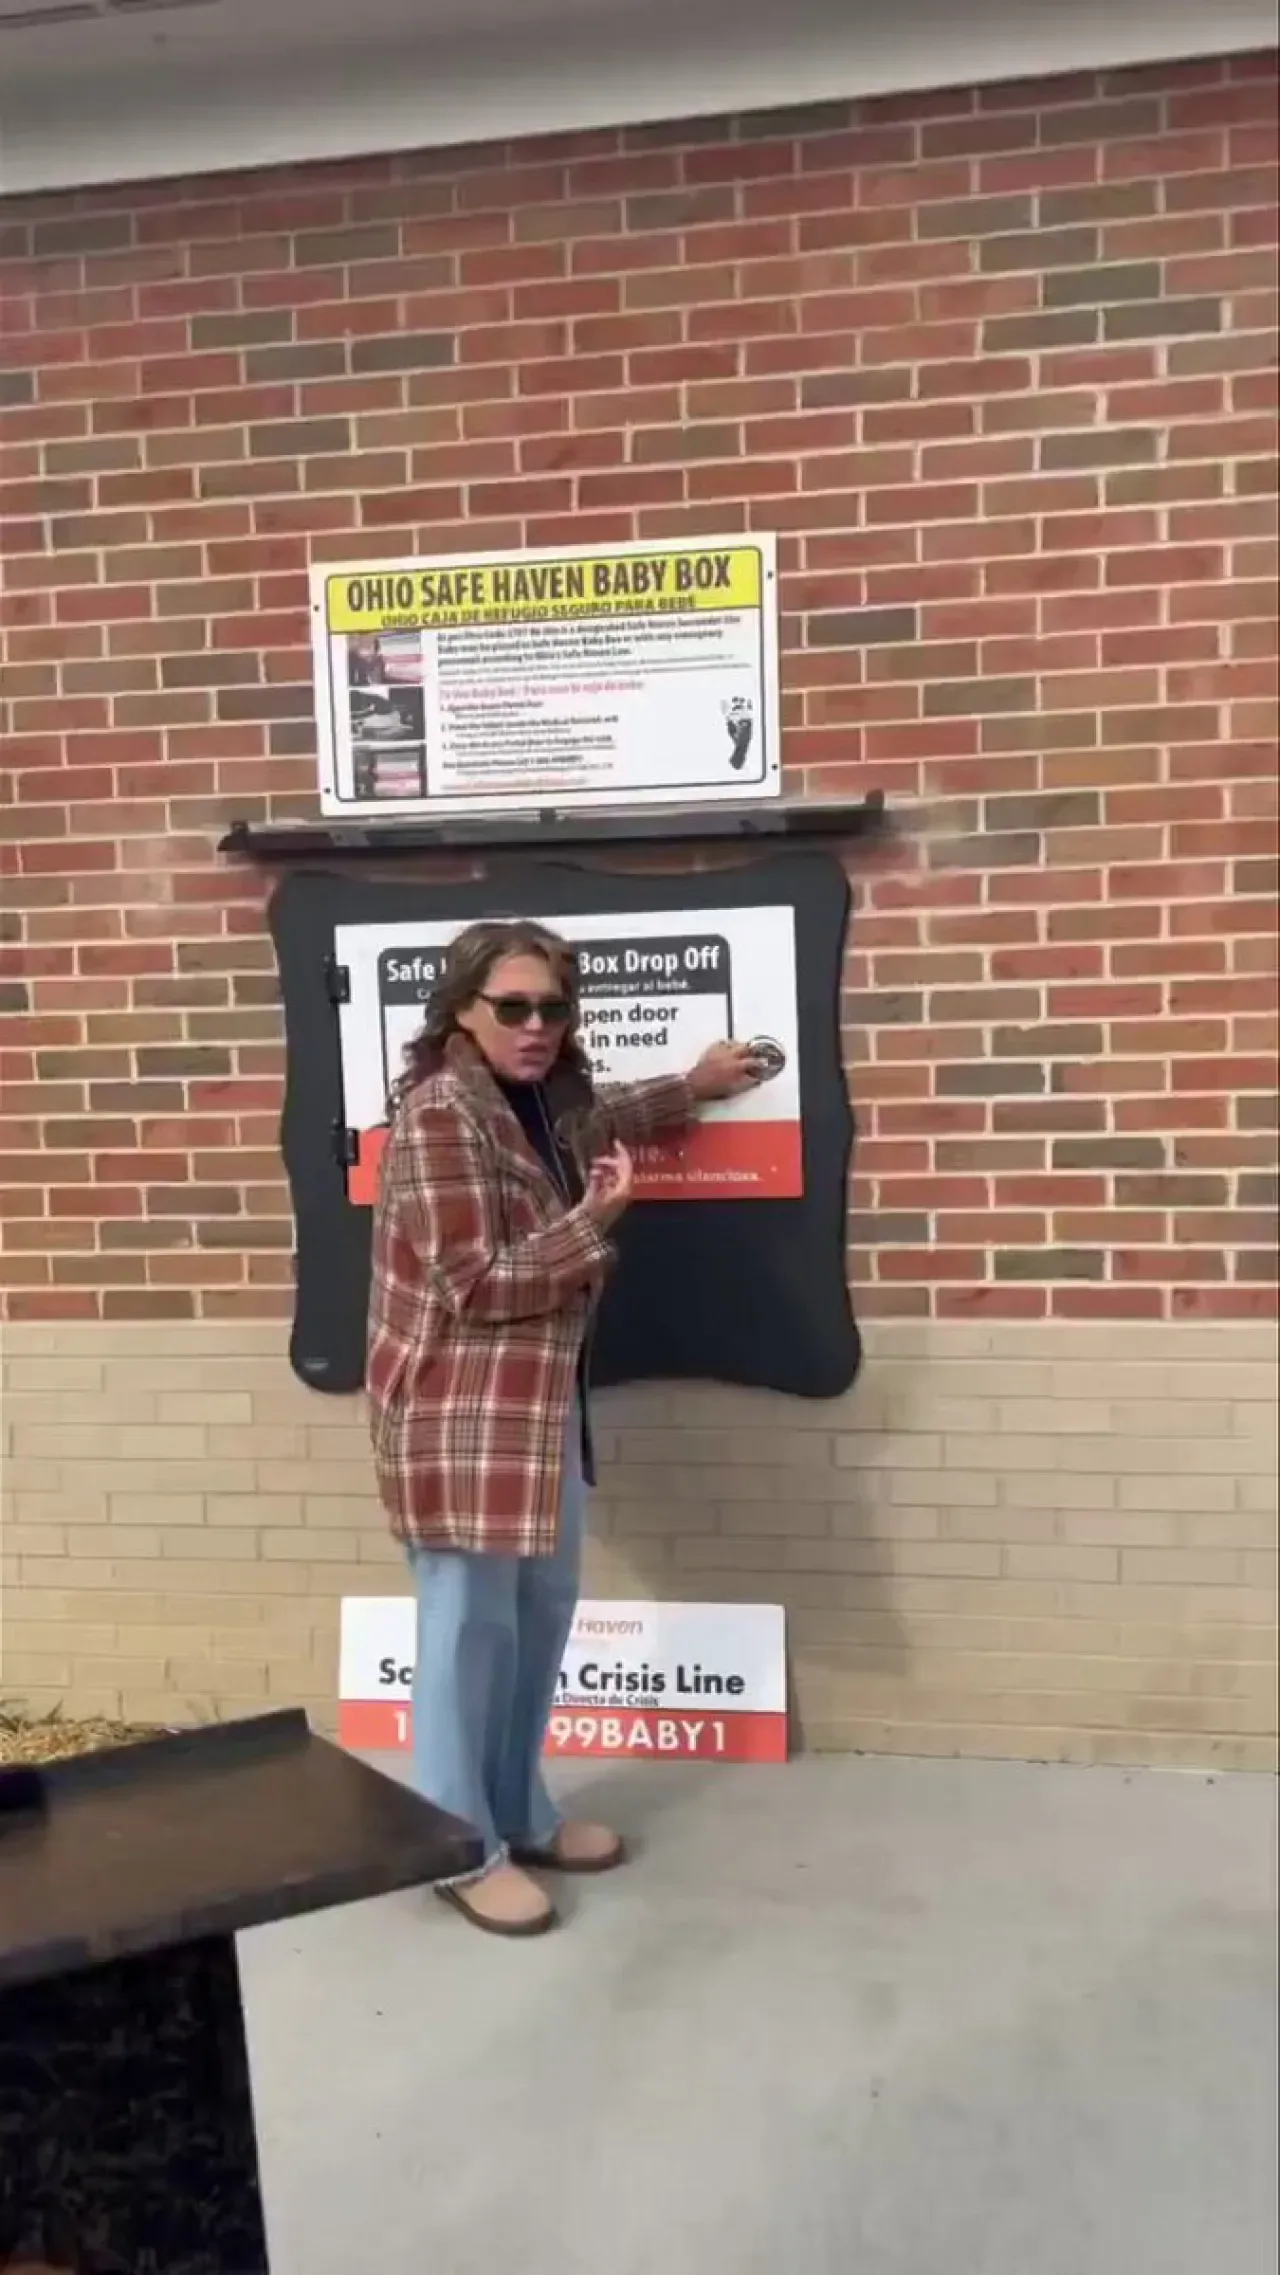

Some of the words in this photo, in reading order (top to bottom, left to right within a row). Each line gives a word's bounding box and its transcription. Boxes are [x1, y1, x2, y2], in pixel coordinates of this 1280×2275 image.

[347, 576, 414, 612] OHIO
[420, 571, 485, 607] SAFE
[492, 564, 585, 603] HAVEN
[592, 559, 667, 597] BABY
[674, 554, 731, 592] BOX
[381, 612, 418, 628] OHIO
[422, 610, 458, 626] CAJA
[460, 608, 480, 623] DE
[483, 603, 549, 622] REFUGIO
[551, 600, 612, 618] SEGURO
[614, 598, 654, 614] PARA
[386, 956, 435, 983] Safe
[624, 948, 679, 977] Drop
[683, 944, 720, 971] Off
[583, 1007, 623, 1026] pen
[627, 1003, 679, 1023] door
[590, 1029, 610, 1049] in
[615, 1027, 668, 1048] need
[578, 1661, 666, 1693] Crisis
[676, 1663, 746, 1695] Line
